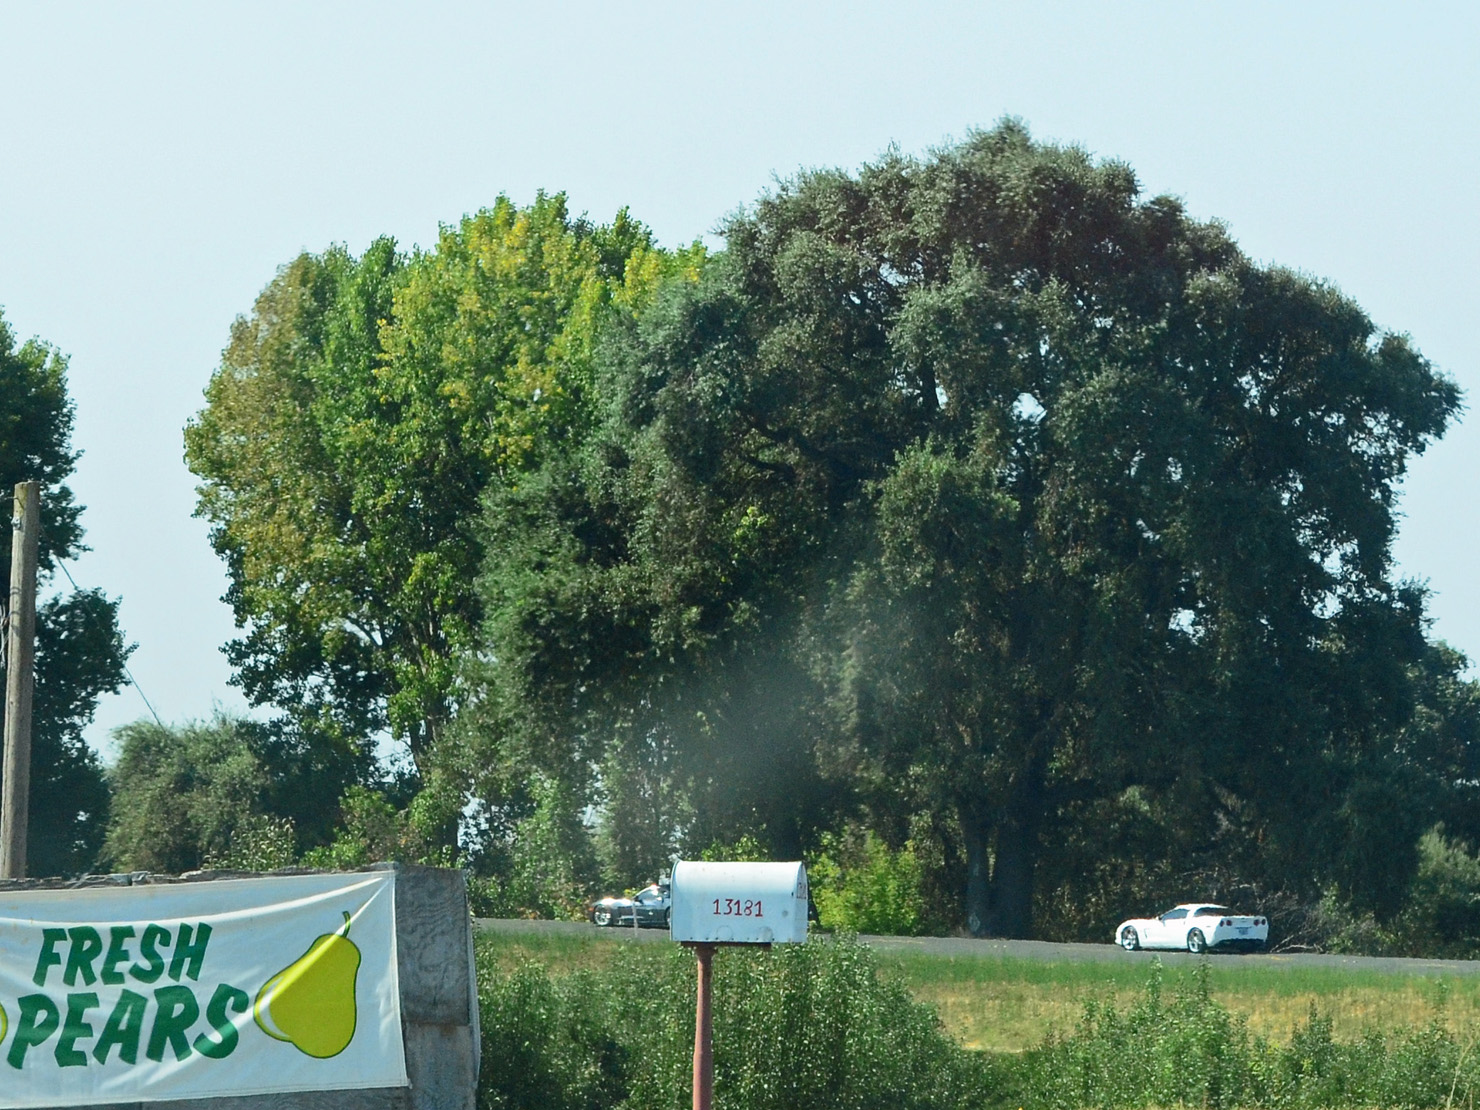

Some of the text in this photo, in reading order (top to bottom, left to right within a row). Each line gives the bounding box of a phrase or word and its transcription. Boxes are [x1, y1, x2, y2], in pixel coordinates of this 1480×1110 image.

[713, 898, 763, 917] 13181
[33, 922, 212, 986] FRESH
[7, 983, 249, 1069] PEARS
